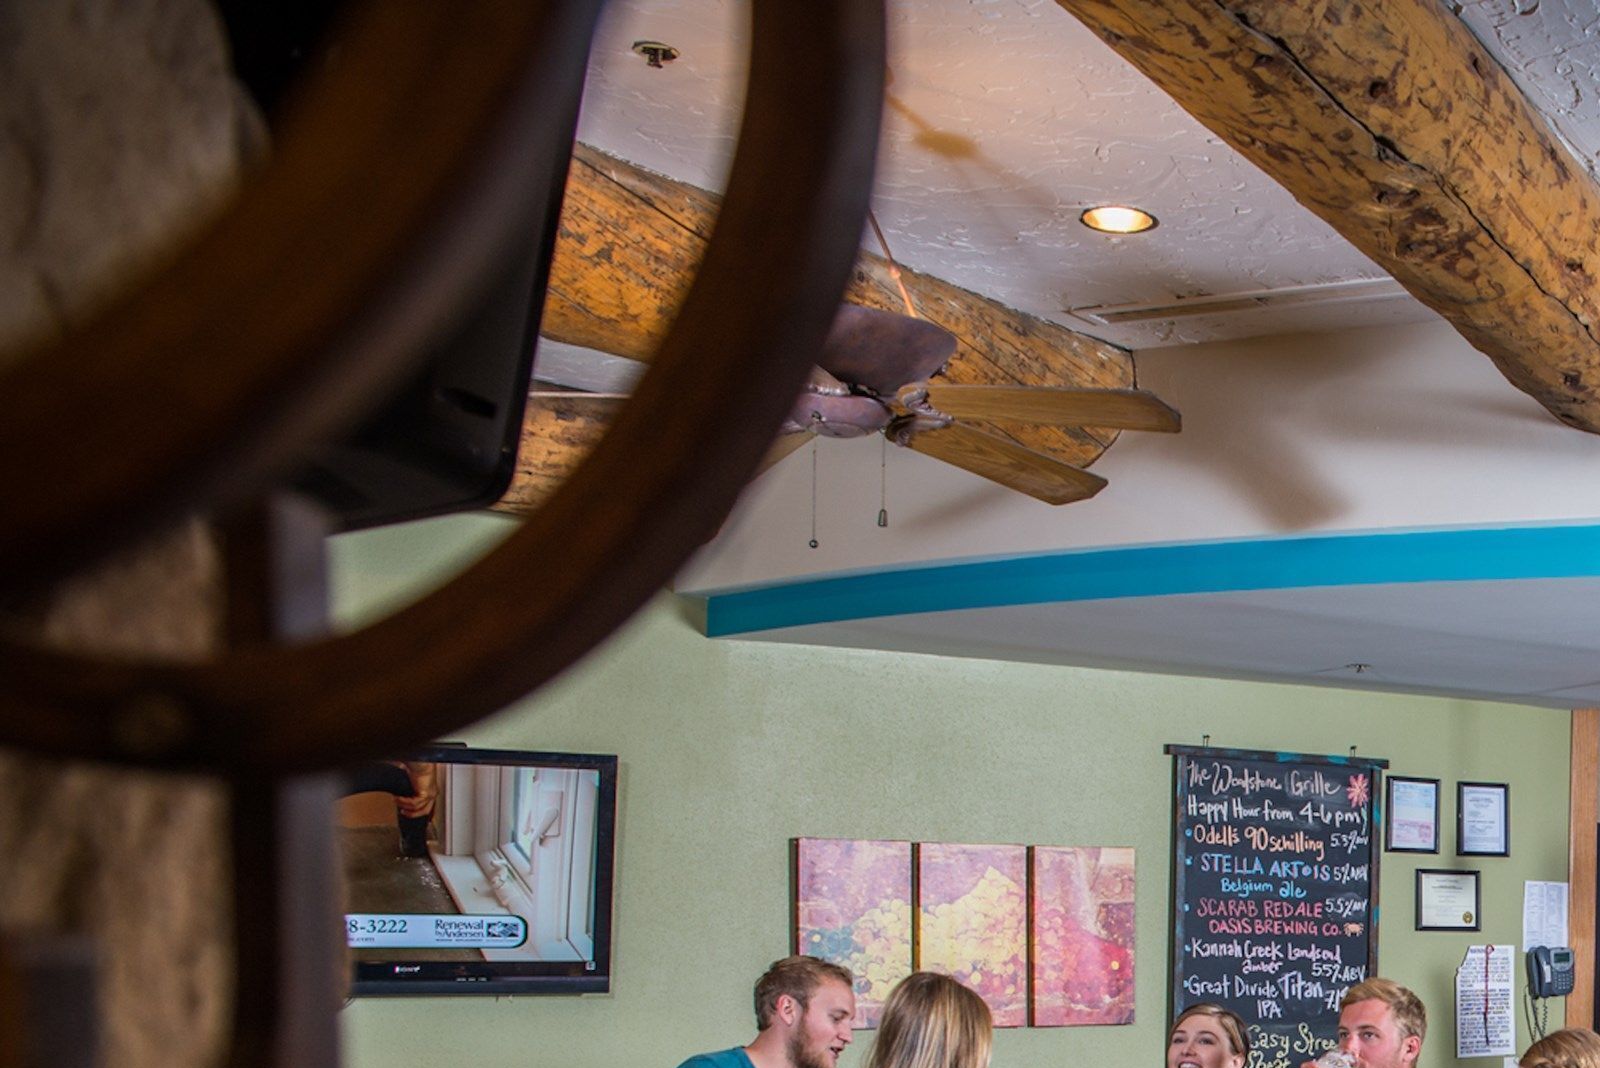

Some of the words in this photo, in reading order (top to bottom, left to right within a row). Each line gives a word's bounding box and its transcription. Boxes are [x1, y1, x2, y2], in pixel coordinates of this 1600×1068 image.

[1187, 760, 1212, 788] The
[1212, 762, 1282, 795] Woodstone
[1290, 770, 1341, 798] Grille
[1188, 794, 1228, 825] Happy
[1232, 797, 1261, 819] Hour
[1262, 799, 1294, 822] from
[1244, 826, 1269, 851] 90
[1201, 852, 1264, 875] STELLA
[1268, 860, 1331, 881] ARTOIS
[1221, 877, 1273, 898] Belgium
[1279, 881, 1307, 898] ale
[1197, 897, 1258, 917] SCARAB
[1263, 900, 1294, 918] RED
[1294, 901, 1323, 918] ALE
[435, 919, 484, 930] Renewal
[1208, 917, 1252, 934] OASIS
[1254, 919, 1318, 937] BREWING
[1191, 937, 1242, 958] Kannah
[1243, 940, 1284, 960] Creek
[1188, 974, 1231, 999] Great
[1234, 974, 1279, 998] Divide
[1277, 970, 1323, 1000] Titan
[1257, 999, 1282, 1019] IPA
[1294, 1022, 1338, 1056] Stree
